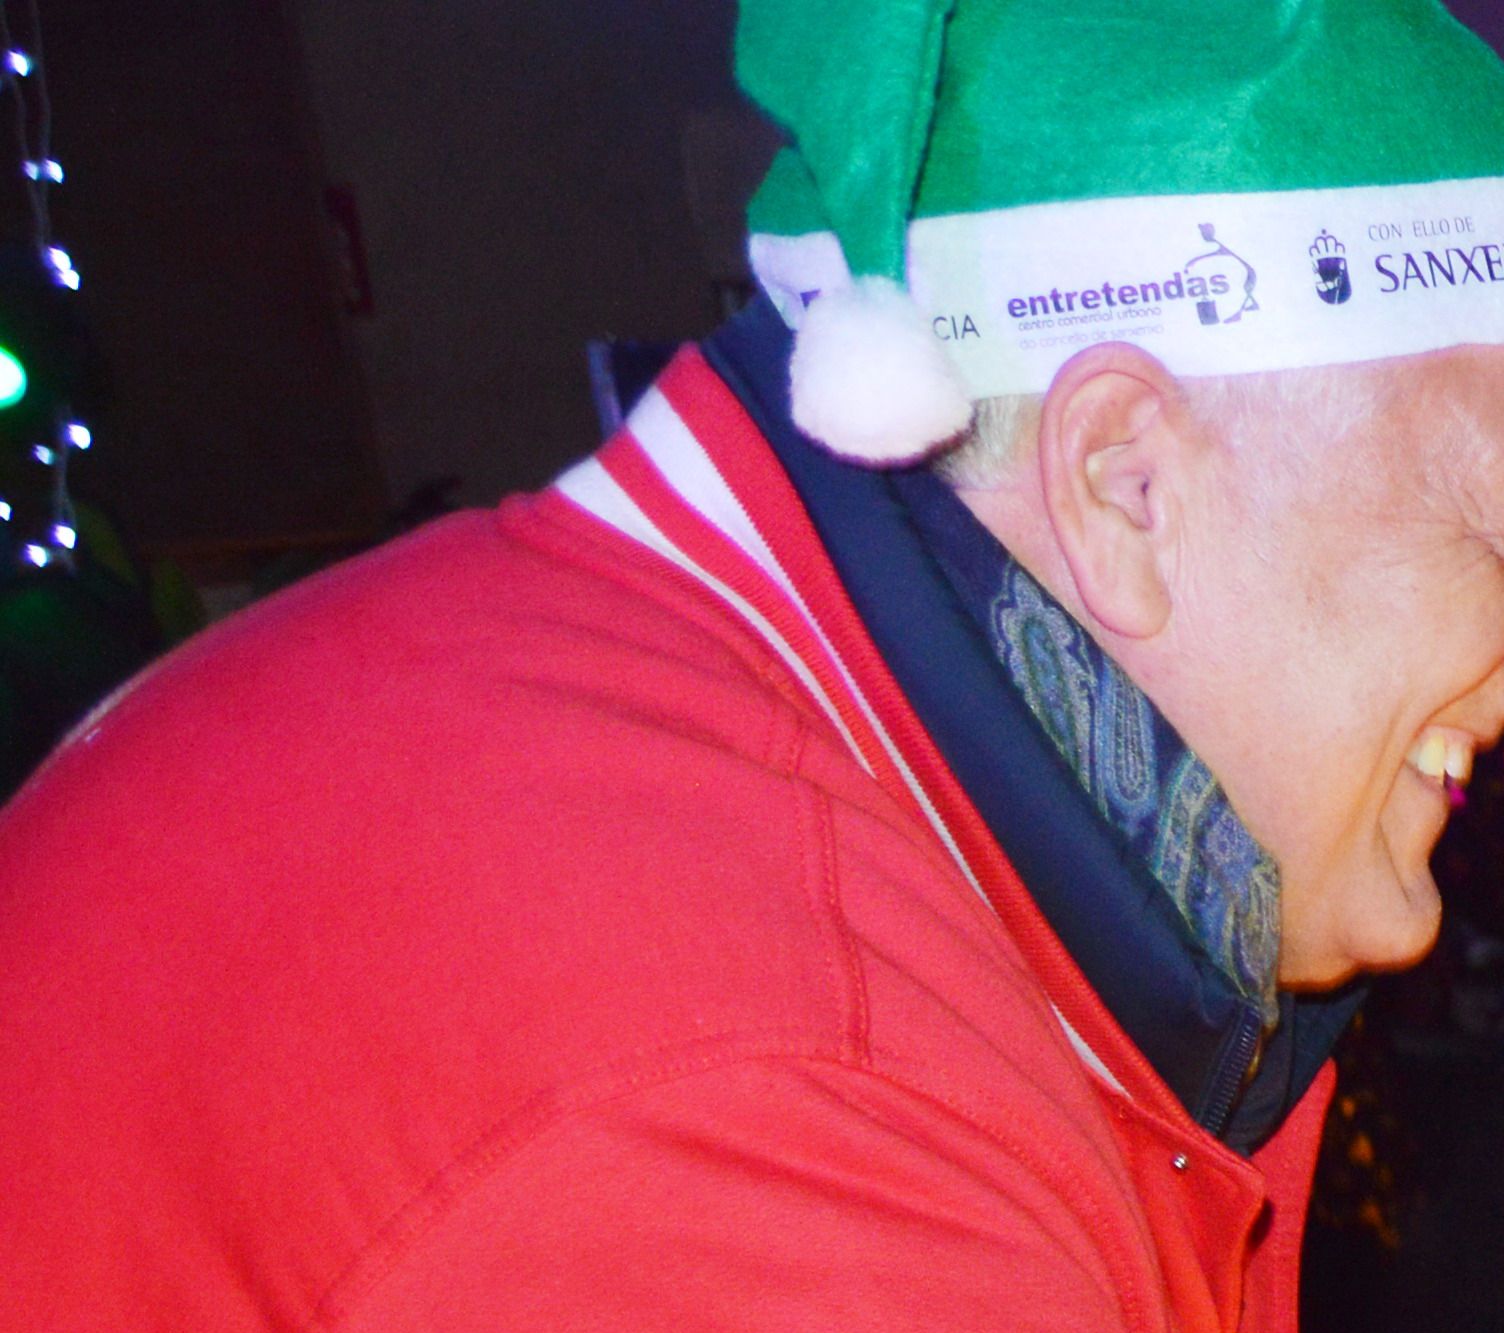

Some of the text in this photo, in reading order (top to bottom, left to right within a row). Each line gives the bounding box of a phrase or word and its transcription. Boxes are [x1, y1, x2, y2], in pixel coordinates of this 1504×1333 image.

[1368, 216, 1476, 242] CONELLO DE
[1007, 270, 1231, 319] entretendas
[932, 314, 981, 341] CIA
[1018, 304, 1163, 332] centro comercial urbano
